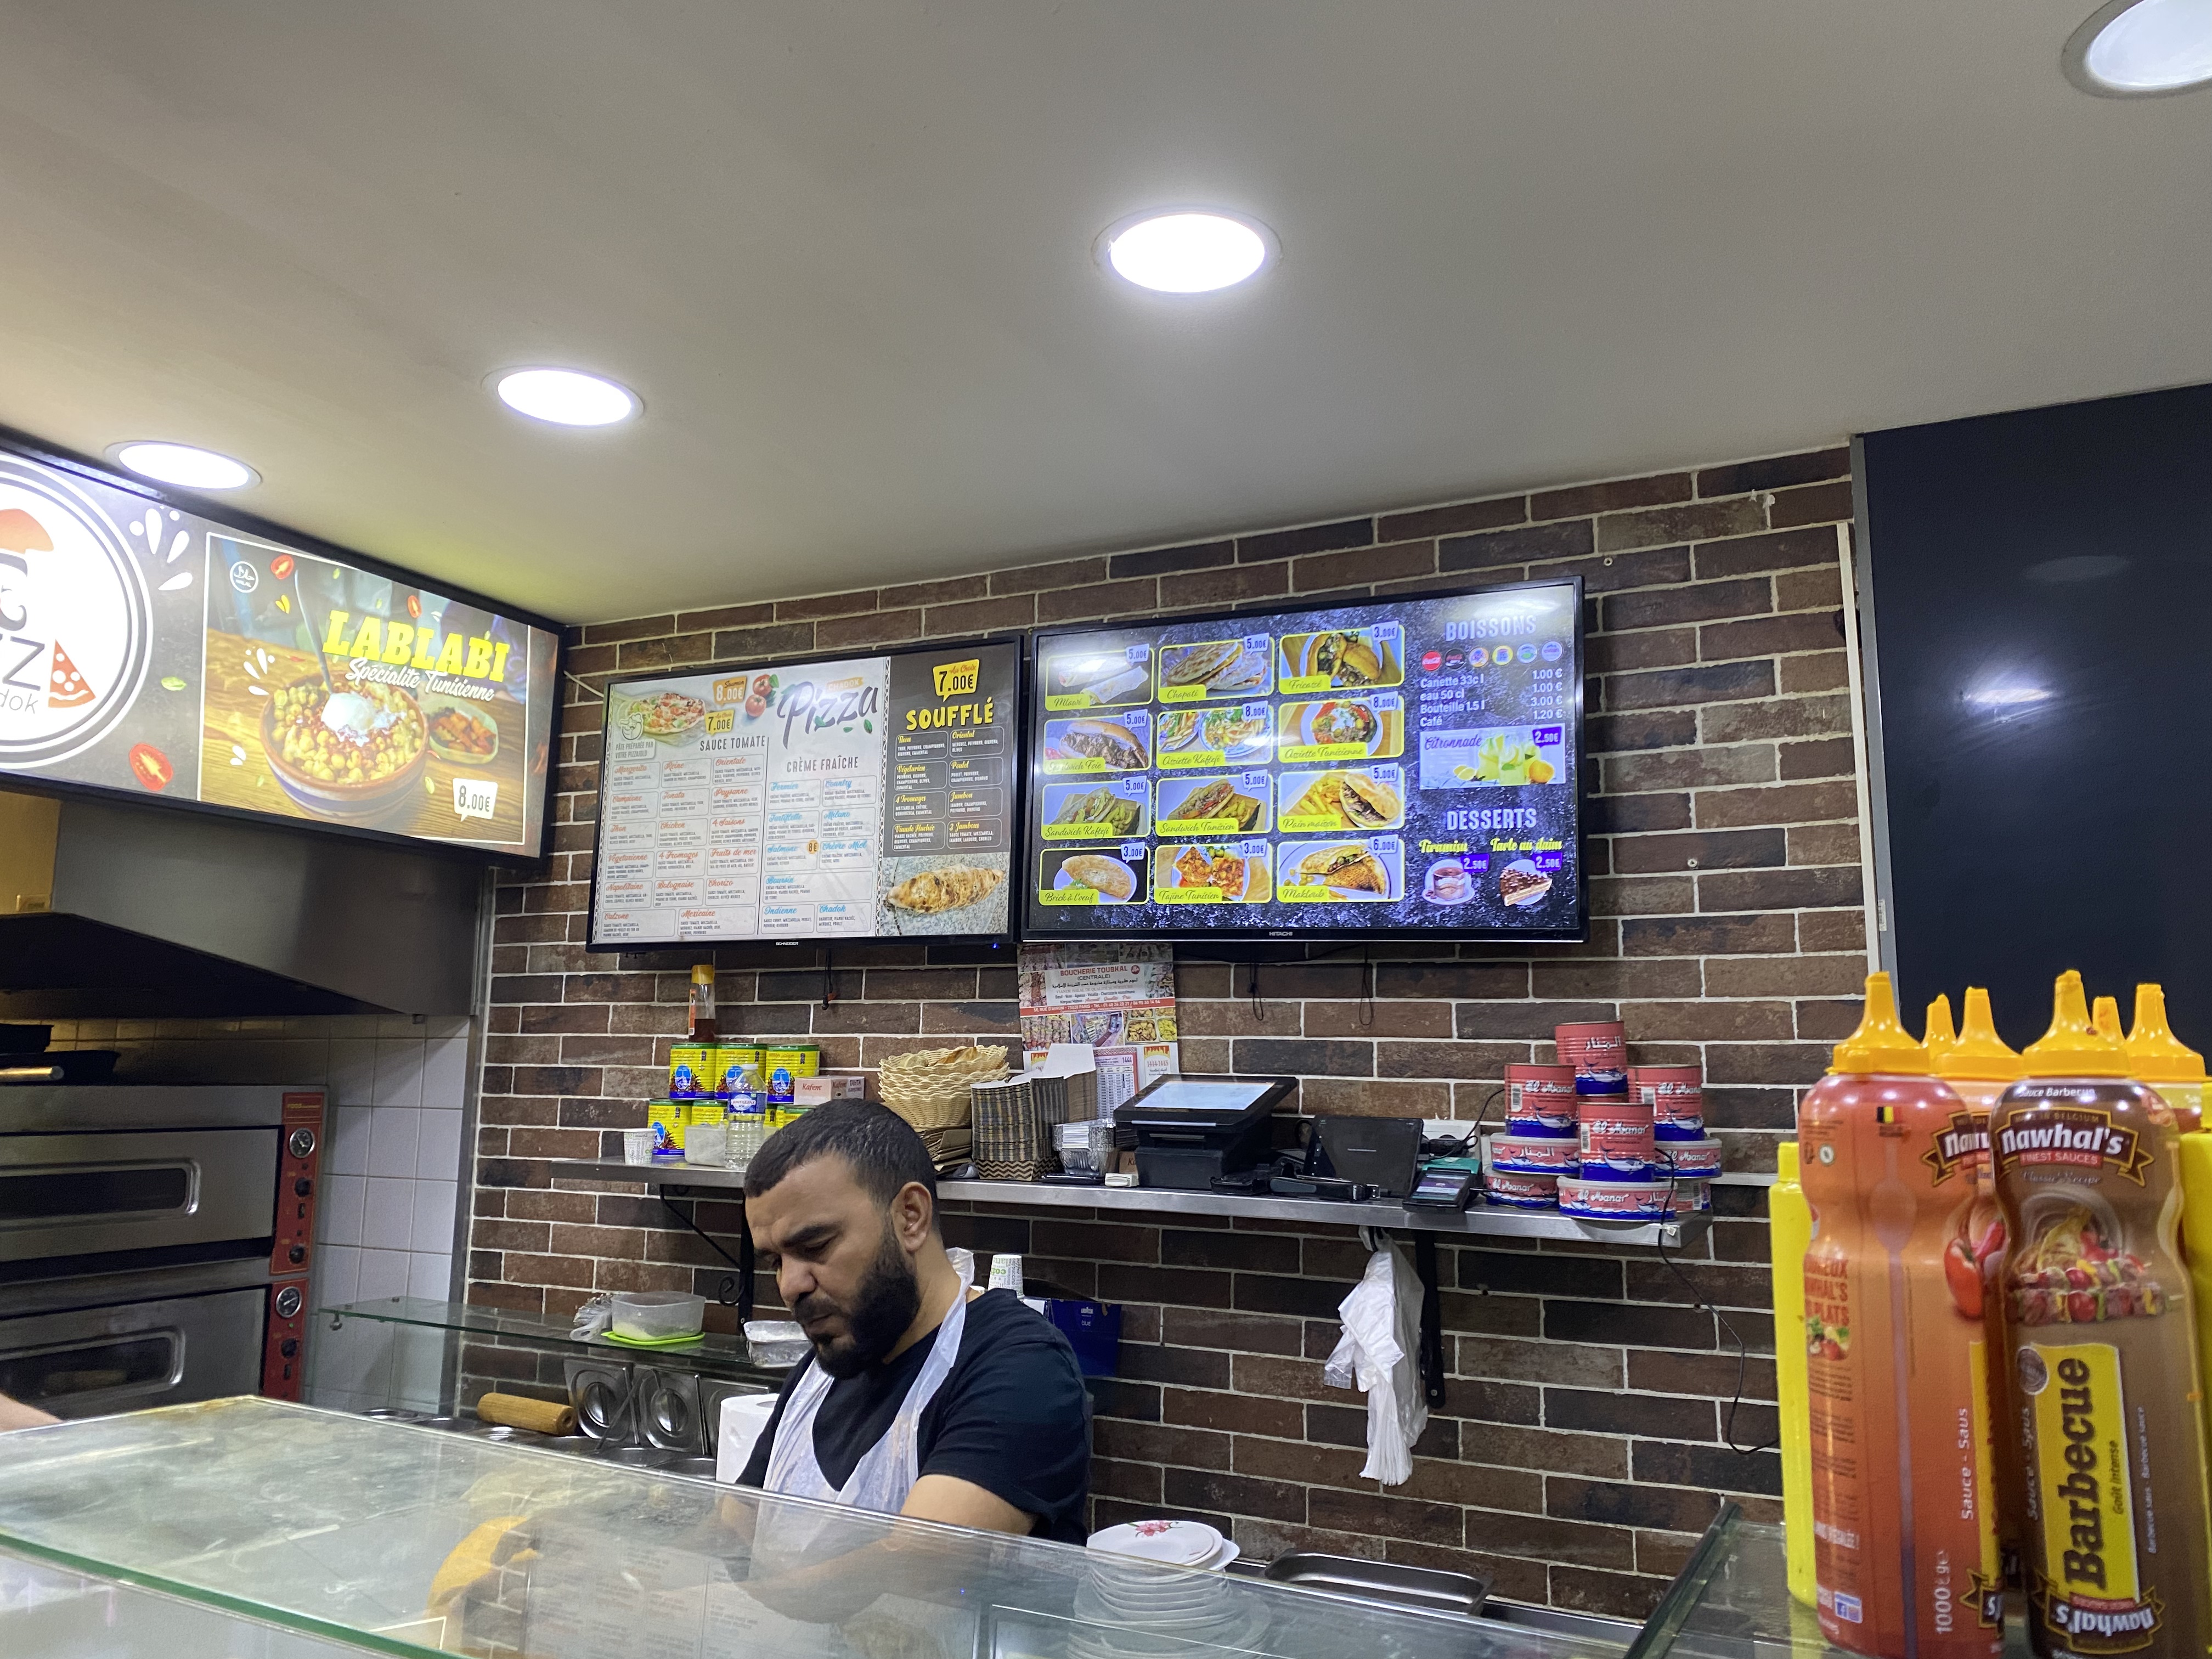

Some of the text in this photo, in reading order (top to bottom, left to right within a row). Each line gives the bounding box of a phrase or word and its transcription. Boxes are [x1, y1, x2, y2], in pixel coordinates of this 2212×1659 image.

[1445, 615, 1536, 641] BOISSONS
[323, 610, 510, 682] LABLABI
[1246, 637, 1266, 650] 5.00€
[1128, 648, 1147, 659] 5.00€
[950, 664, 976, 674] Au Choix
[1532, 668, 1562, 680] 1.00 €
[345, 657, 494, 701] Spécialité Tunisienne
[939, 671, 974, 692] 7.00€
[1420, 676, 1458, 689] Canette
[716, 685, 743, 701] 8.00€
[1532, 682, 1562, 693] 1.00 €
[1167, 689, 1198, 699] Chapati
[1420, 689, 1465, 701] eau 50 cl
[1054, 698, 1082, 707] Mlawi
[1373, 696, 1396, 708] 8.00€
[1530, 696, 1562, 706] 3.00 €
[906, 697, 994, 731] SOUFFLÉ
[1245, 705, 1265, 716] 8.00€
[1420, 702, 1465, 714] Bouteille
[777, 681, 878, 749] Pizza
[1126, 714, 1146, 725] 5.00€
[1533, 709, 1562, 720] 1.20 €
[708, 716, 730, 731] 7.00€
[1420, 716, 1442, 727] Café
[1425, 733, 1481, 750] Citronnade
[1534, 731, 1559, 743] 2.50€
[700, 736, 765, 751] SAUCE TOMATE
[1285, 747, 1363, 759] Assiette Tunisienne
[715, 757, 746, 766] Orientale
[787, 755, 859, 772] CRÈME FRAÎCHE
[1085, 760, 1102, 770] Foie
[1162, 753, 1220, 766] Assiette Kafteji
[664, 761, 685, 771] Reine
[1374, 767, 1396, 780] 5.00€
[825, 779, 853, 789] Country
[1125, 780, 1144, 791] 5.00€
[1244, 774, 1265, 786] 5.00€
[459, 785, 490, 812] 8.00€
[714, 788, 748, 799] Paysanne
[824, 810, 850, 820] Milano
[1446, 808, 1537, 831] DESSERTS
[1160, 821, 1235, 833] Sandwich Tunisien
[1283, 818, 1306, 828] Pain
[1045, 826, 1110, 838] Sandwich Kafteji
[1124, 845, 1142, 857] 3.00€
[1244, 843, 1264, 854] 3.00€
[1374, 839, 1396, 851] 6.00€
[1490, 838, 1517, 852] Tarte
[1519, 841, 1532, 851] au
[665, 851, 698, 862] Fromages
[710, 848, 731, 857] Fruits
[1463, 858, 1487, 871] 2.50€
[1536, 856, 1560, 868] 2.50€
[656, 881, 694, 891] Bolognaise
[1045, 893, 1066, 902] Brick
[1159, 890, 1220, 904] Tajine Tunisien
[1283, 889, 1324, 899] Makloub
[681, 910, 715, 918] Mexicaine
[819, 905, 846, 913] Chadok
[1060, 966, 1128, 977] BOUCHERIE TOUBKAL
[1585, 1036, 1621, 1051] المنار
[2002, 1122, 2124, 1155] nawhal's
[1520, 1146, 1554, 1158] المنار
[2021, 1153, 2098, 1164] FINEST SAUCES
[1959, 1408, 1974, 1520] Sauce Saus
[2057, 1357, 2106, 1590] Barbecue
[1934, 1586, 1953, 1634] 1000
[2056, 1604, 2155, 1637] nawhal's
